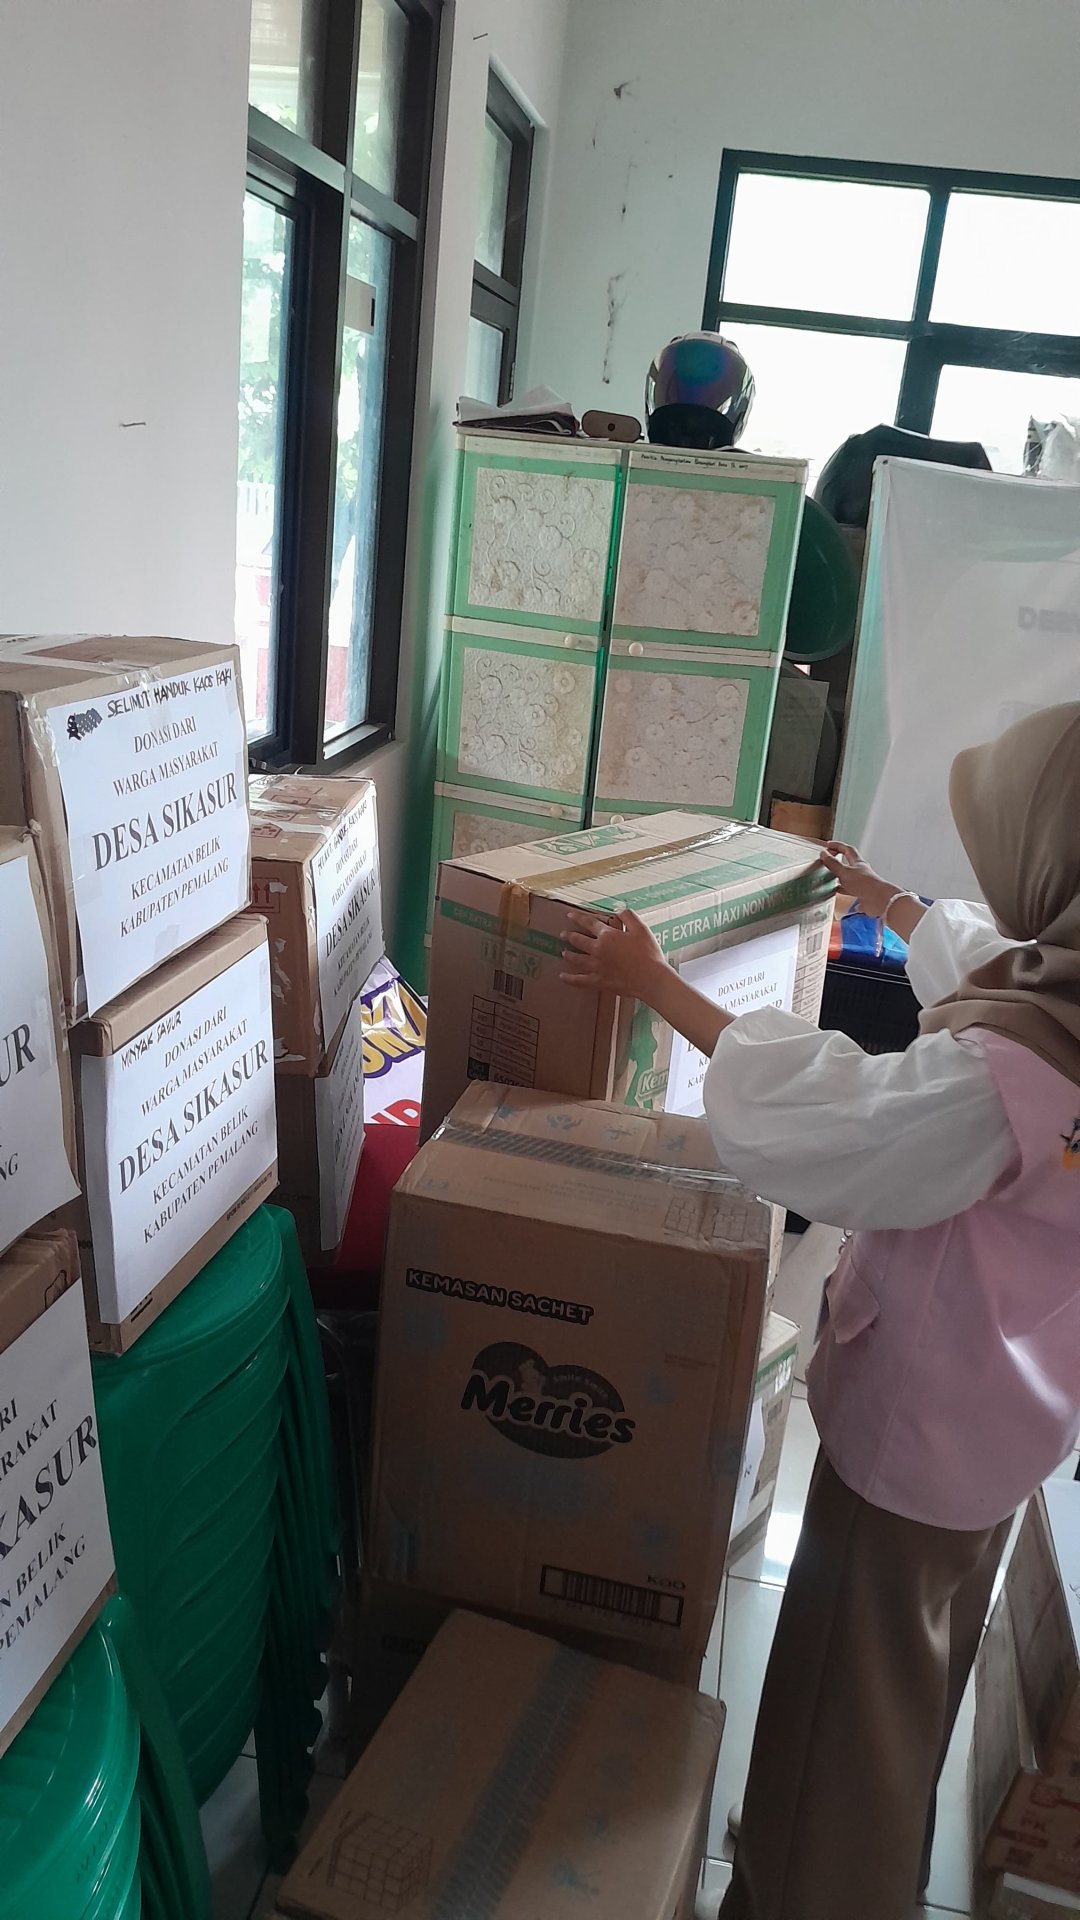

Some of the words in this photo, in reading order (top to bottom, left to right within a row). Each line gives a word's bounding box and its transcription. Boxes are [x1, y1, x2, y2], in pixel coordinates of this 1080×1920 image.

[107, 689, 150, 718] SELIMUT
[153, 680, 191, 704] HANDUK
[193, 675, 214, 693] KAOS
[215, 668, 232, 686] KAKI
[113, 769, 157, 798] WARGA
[157, 741, 219, 788] MASYARAKAT
[133, 724, 173, 753] DONASI
[172, 716, 197, 738] DARI
[92, 811, 159, 872] DESA
[162, 772, 238, 841] SIKASUR
[120, 888, 182, 939] KABUPATEN
[181, 857, 230, 909] PEMALANG
[130, 853, 195, 901] KECAMATAN
[195, 836, 222, 868] BELIK
[325, 917, 348, 958] DESA
[347, 868, 376, 927] SIKASUR
[672, 916, 711, 942] EXTRA
[713, 906, 740, 929] MAXI
[742, 897, 766, 919] NON
[718, 977, 746, 997] DONASI
[749, 971, 765, 986] DARI
[730, 982, 778, 1011] MASYARAKAT
[141, 1075, 180, 1117] WARGA
[182, 1018, 249, 1083] MASYARAKAT
[165, 1025, 201, 1068] DONASI
[204, 1005, 226, 1036] DARI
[118, 1116, 181, 1195] DESA
[183, 1039, 269, 1135] SIKASUR
[144, 1172, 207, 1244] KABUPATEN
[206, 1120, 259, 1181] PEMALANG
[153, 1133, 220, 1205] KECAMATAN
[219, 1105, 249, 1142] BELIK
[408, 1269, 504, 1303] KEMASAN
[511, 1292, 591, 1322] SACHET
[0, 1400, 57, 1482] RAKAT
[461, 1374, 636, 1443] Merries
[16, 1522, 66, 1597] BELIK
[0, 1535, 86, 1661] EMALANG
